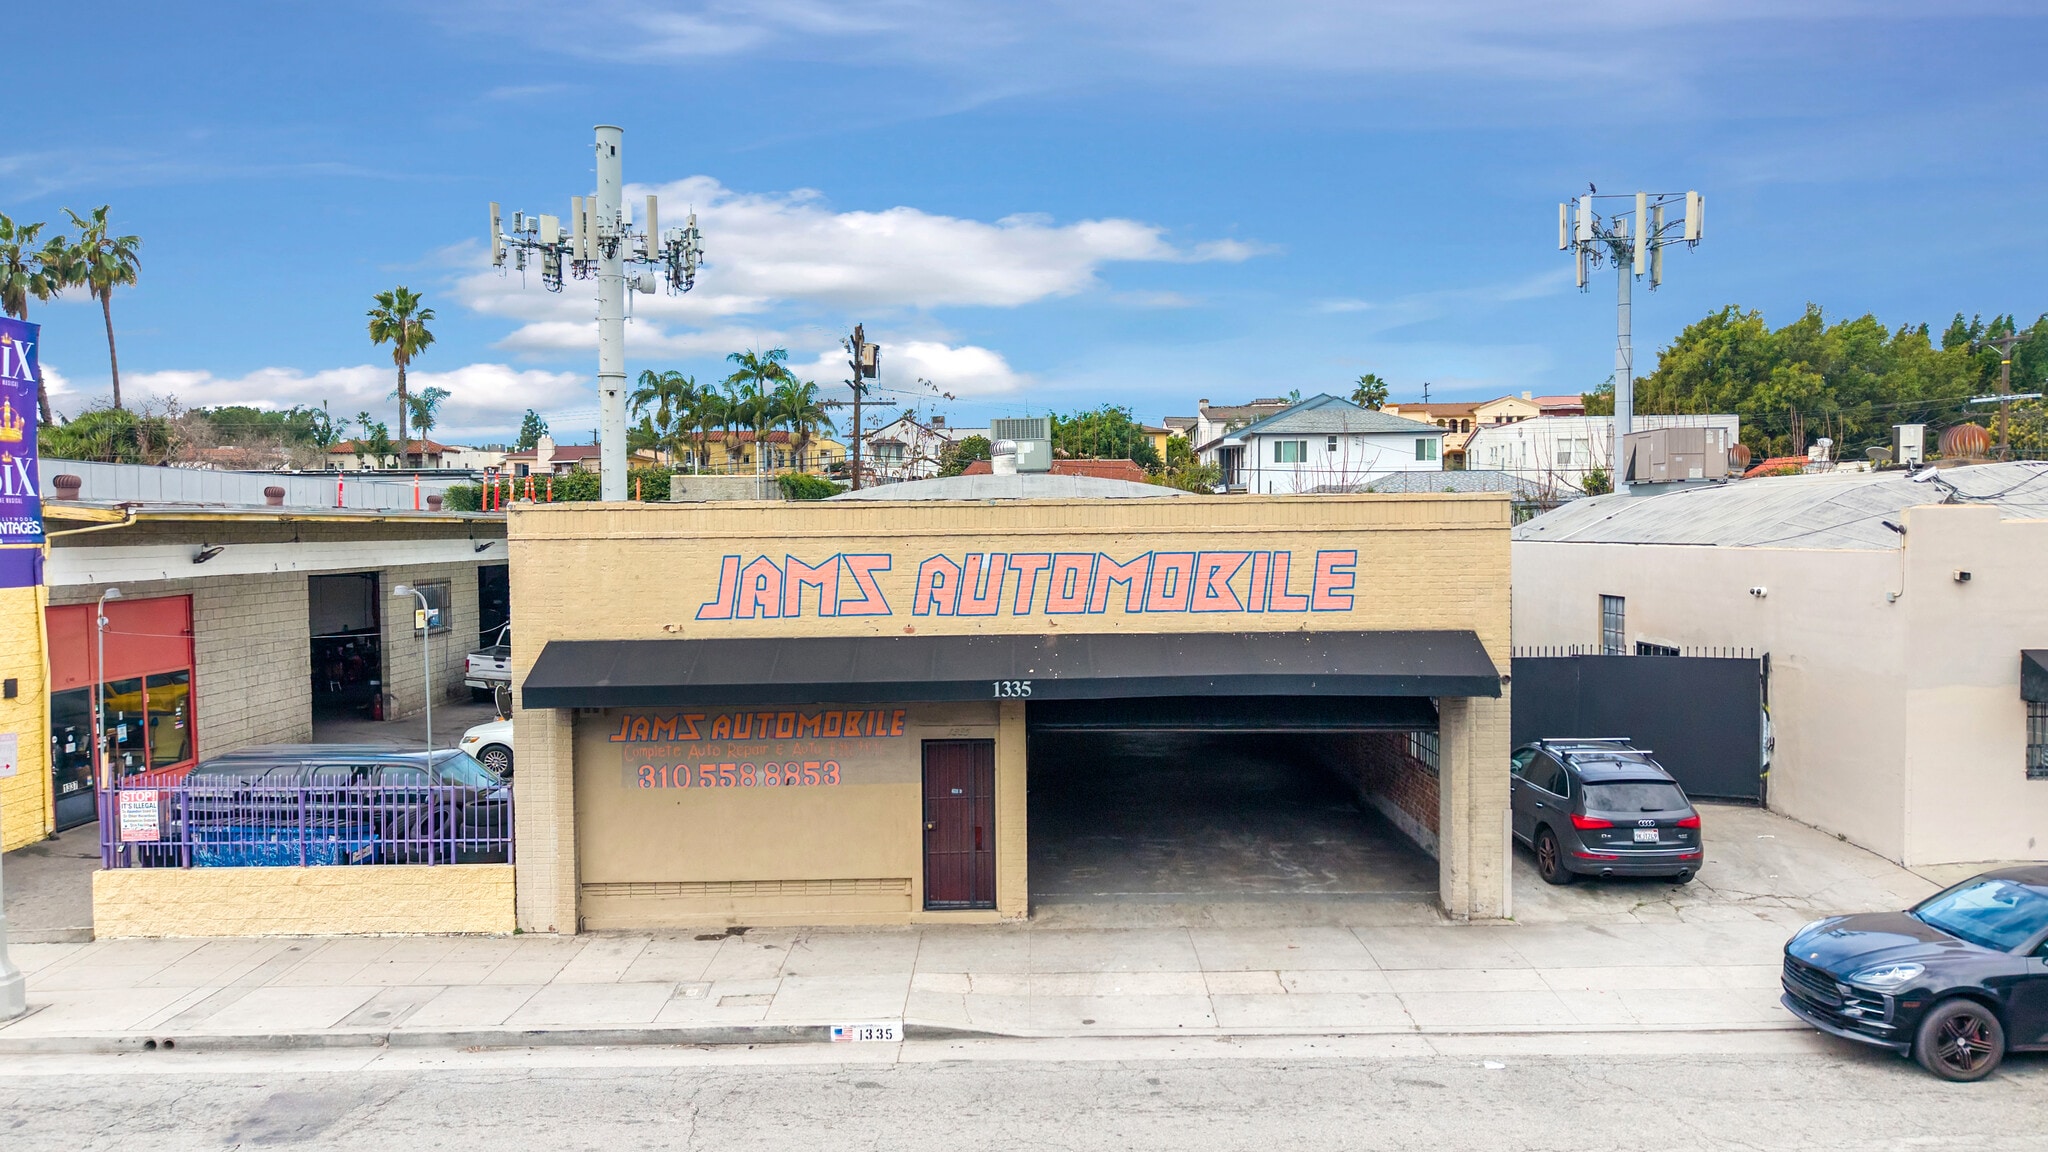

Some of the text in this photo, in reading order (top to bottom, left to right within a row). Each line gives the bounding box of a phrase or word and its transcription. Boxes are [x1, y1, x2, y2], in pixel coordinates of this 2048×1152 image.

[912, 549, 1358, 617] AUTOMOBILE
[992, 681, 1032, 698] 1335
[709, 708, 907, 741] AUTOMOBILE
[727, 743, 769, 759] Repair
[638, 759, 842, 789] 310 558 8853
[122, 791, 156, 801] STOP!
[860, 1028, 893, 1041] 1335
